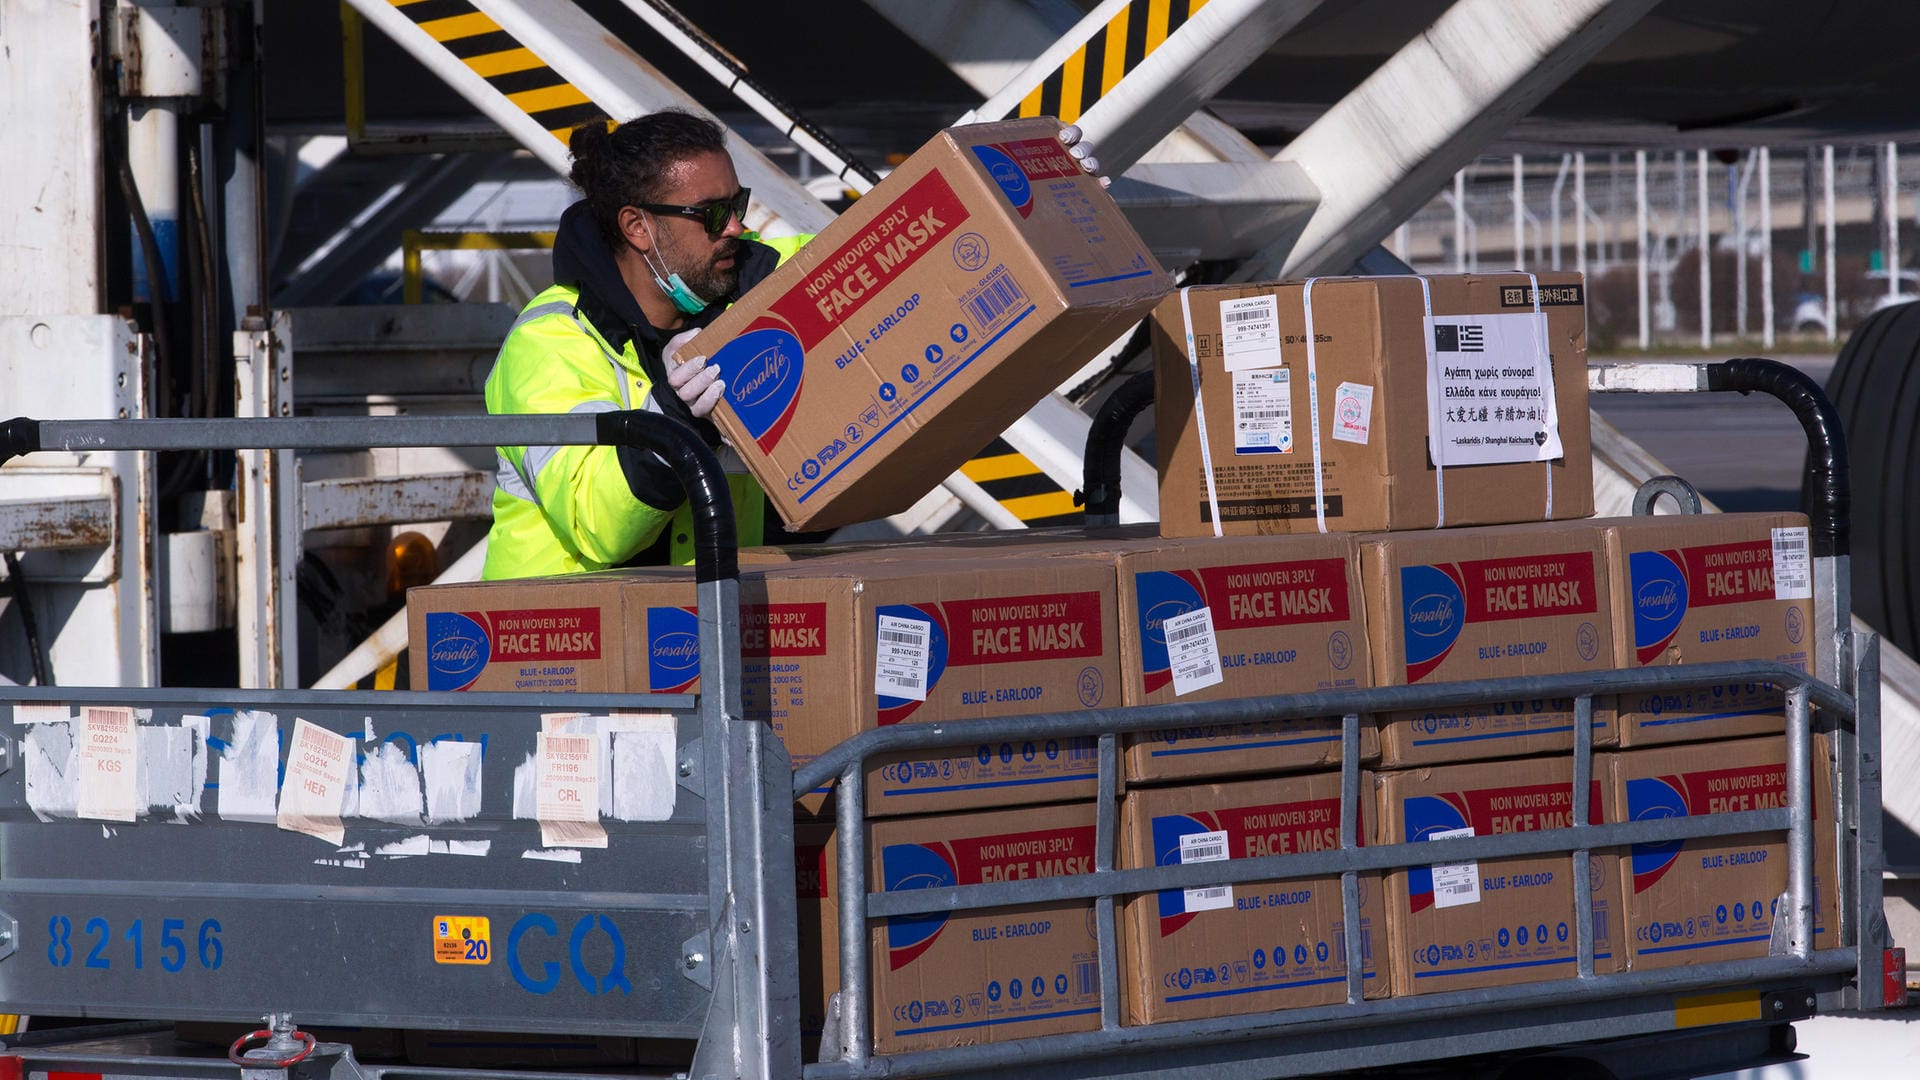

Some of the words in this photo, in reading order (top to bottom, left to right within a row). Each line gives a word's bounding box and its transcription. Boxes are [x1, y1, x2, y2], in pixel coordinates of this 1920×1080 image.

[1020, 156, 1045, 174] FACE
[1044, 155, 1073, 172] MASK
[805, 269, 836, 298] NON
[832, 231, 880, 274] WOVEN
[878, 205, 909, 237] 3PLY
[816, 263, 878, 322] FACE
[873, 207, 946, 274] MASK
[834, 341, 865, 369] BLUE
[870, 293, 920, 341] EARLOOP
[1444, 366, 1472, 380] Αγάπη
[1474, 366, 1499, 379] χωρίς
[1501, 366, 1534, 379] σύνορα!
[1445, 386, 1475, 398] Ελλάδα
[1478, 387, 1497, 397] κάνε
[1500, 386, 1541, 399] κουράγιο!
[1485, 436, 1508, 446] Shanghai
[1508, 436, 1534, 445] Kaichuang
[787, 472, 805, 490] CE
[816, 439, 847, 466] FDA
[1705, 553, 1724, 567] NON
[1726, 550, 1756, 566] WOVEN
[1758, 548, 1772, 562] 3PL
[1227, 574, 1250, 588] NON
[1252, 571, 1289, 586] WOVEN
[1291, 569, 1315, 584] 3PLY
[1485, 568, 1505, 582] NON
[1507, 565, 1541, 580] WOVEN
[1543, 563, 1565, 577] 3PLY
[1706, 571, 1745, 597] FACE
[1229, 592, 1276, 620] FACE
[1281, 588, 1334, 615] MASK
[1485, 586, 1528, 613] FACE
[1533, 581, 1582, 608] MASK
[745, 613, 781, 625] WOVEN
[783, 613, 806, 624] 3PLY
[972, 608, 996, 622] NON
[998, 605, 1039, 621] WOVEN
[1041, 603, 1067, 617] 3PLY
[499, 619, 520, 630] NON
[521, 618, 556, 629] WOVEN
[558, 617, 581, 628] 3PLY
[499, 634, 540, 654] FACE
[546, 632, 595, 652] MASK
[771, 628, 820, 648] MASK
[972, 627, 1022, 656] FACE
[1028, 623, 1085, 651] MASK
[1700, 629, 1720, 642] BLUE
[1726, 625, 1761, 640] EARLOOP
[1222, 654, 1246, 668] BLUE
[1254, 650, 1297, 665] EARLOOP
[1479, 646, 1500, 660] BLUE
[1508, 642, 1547, 656] EARLOOP
[520, 668, 538, 677] BLUE
[543, 667, 575, 675] EARLOOP
[768, 664, 800, 672] EARLOOP
[549, 679, 564, 687] 2000
[565, 678, 577, 686] PCS
[962, 690, 987, 704] BLUE
[996, 687, 1043, 702] EARLOOP
[1411, 719, 1423, 732] CE
[97, 759, 122, 773] KGS
[552, 764, 579, 772] FR1196
[882, 765, 896, 781] CE
[914, 763, 938, 778] FDA
[304, 779, 326, 798] HER
[1708, 779, 1729, 793] NON
[1730, 775, 1763, 790] WOVEN
[1765, 772, 1786, 787] 3PLY
[558, 789, 581, 801] CRL
[1491, 797, 1512, 811] NON
[1513, 794, 1548, 809] WOVEN
[1550, 792, 1573, 806] 3PLY
[1755, 791, 1787, 812] MAS
[1244, 816, 1267, 829] NON
[1269, 812, 1306, 827] WOVEN
[1308, 809, 1331, 823] 3PLY
[1491, 814, 1534, 835] FACE
[1540, 811, 1573, 832] MAS
[980, 846, 1005, 861] NON
[1006, 841, 1047, 857] WOVEN
[1049, 837, 1074, 853] 3PLY
[1245, 833, 1290, 858] FACE
[1296, 827, 1341, 852] MAS
[981, 863, 1029, 883] FACE
[1035, 856, 1090, 879] MASK
[1702, 857, 1724, 870] BLUE
[1730, 851, 1767, 866] EARLOOP
[1483, 877, 1505, 891] BLUE
[1513, 872, 1553, 888] EARLOOP
[1238, 897, 1260, 911] BLUE
[1269, 890, 1311, 906] EARLOOP
[972, 927, 997, 941] BLUE
[1006, 921, 1052, 940] EARLOOP
[1637, 926, 1649, 940] CE
[1663, 922, 1683, 937] FDA
[48, 915, 223, 972] 82156
[465, 939, 488, 960] 20
[508, 913, 632, 996] GQ
[1413, 949, 1426, 964] CE
[1442, 945, 1463, 960] FDA
[1164, 972, 1177, 988] CE
[1194, 968, 1217, 984] FDA
[893, 1005, 907, 1022] CE
[925, 1002, 949, 1016] FDA
